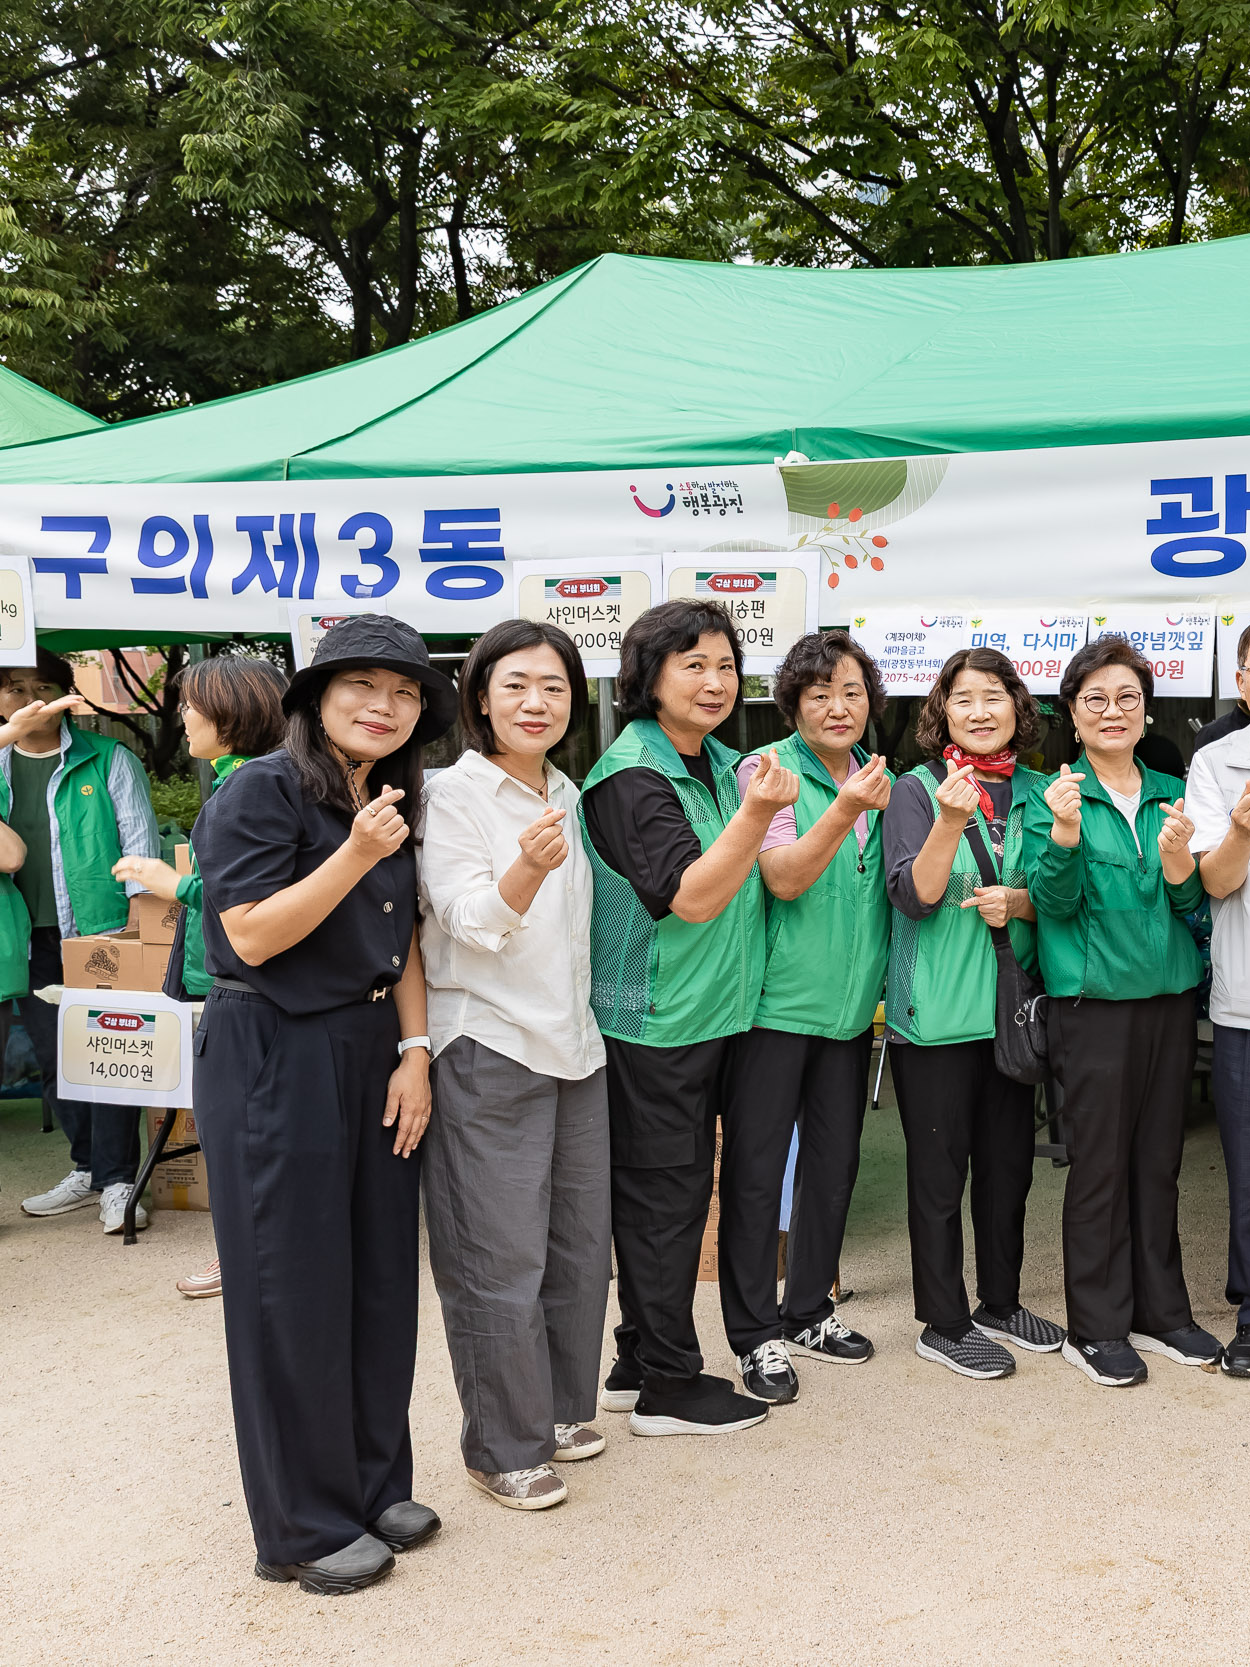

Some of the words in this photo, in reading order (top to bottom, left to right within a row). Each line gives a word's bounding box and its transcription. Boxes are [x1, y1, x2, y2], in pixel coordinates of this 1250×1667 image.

[679, 481, 708, 495] 소통하며
[708, 480, 739, 494] 발전하는
[682, 493, 743, 516] 행복광진
[32, 508, 506, 600] 구의제3동
[580, 583, 601, 594] 부녀회
[733, 578, 755, 588] 부녀회
[546, 604, 621, 624] 샤인머스켓
[574, 631, 621, 650] 000원
[883, 645, 925, 655] 새마을금고
[972, 633, 1010, 651] 미역,
[1023, 633, 1078, 651] 다시마
[86, 1036, 154, 1057] 샤인머스켓
[89, 1061, 153, 1082] 14,000원
